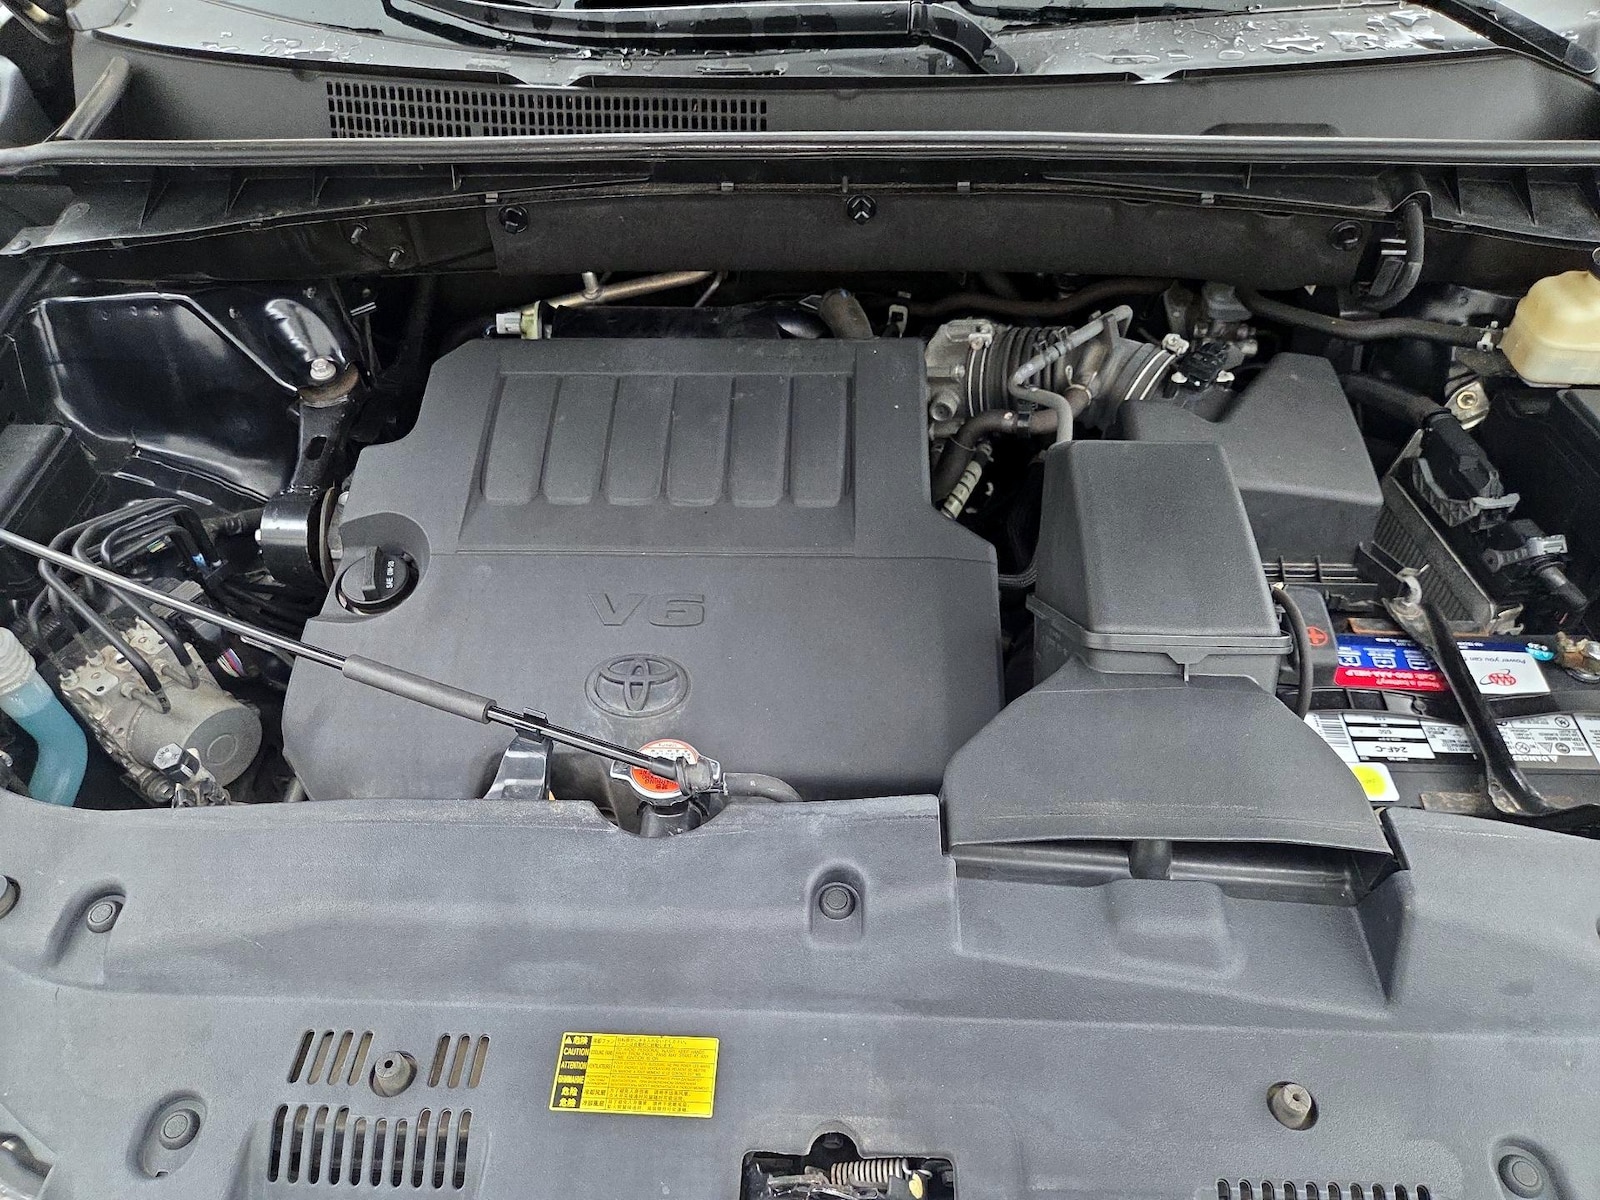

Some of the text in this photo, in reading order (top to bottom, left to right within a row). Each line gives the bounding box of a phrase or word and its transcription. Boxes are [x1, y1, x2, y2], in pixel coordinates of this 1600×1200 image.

[587, 593, 705, 627] V6
[1490, 675, 1515, 685] AAA
[564, 1048, 589, 1056] CAUTION
[561, 1061, 587, 1069] ATTENTION
